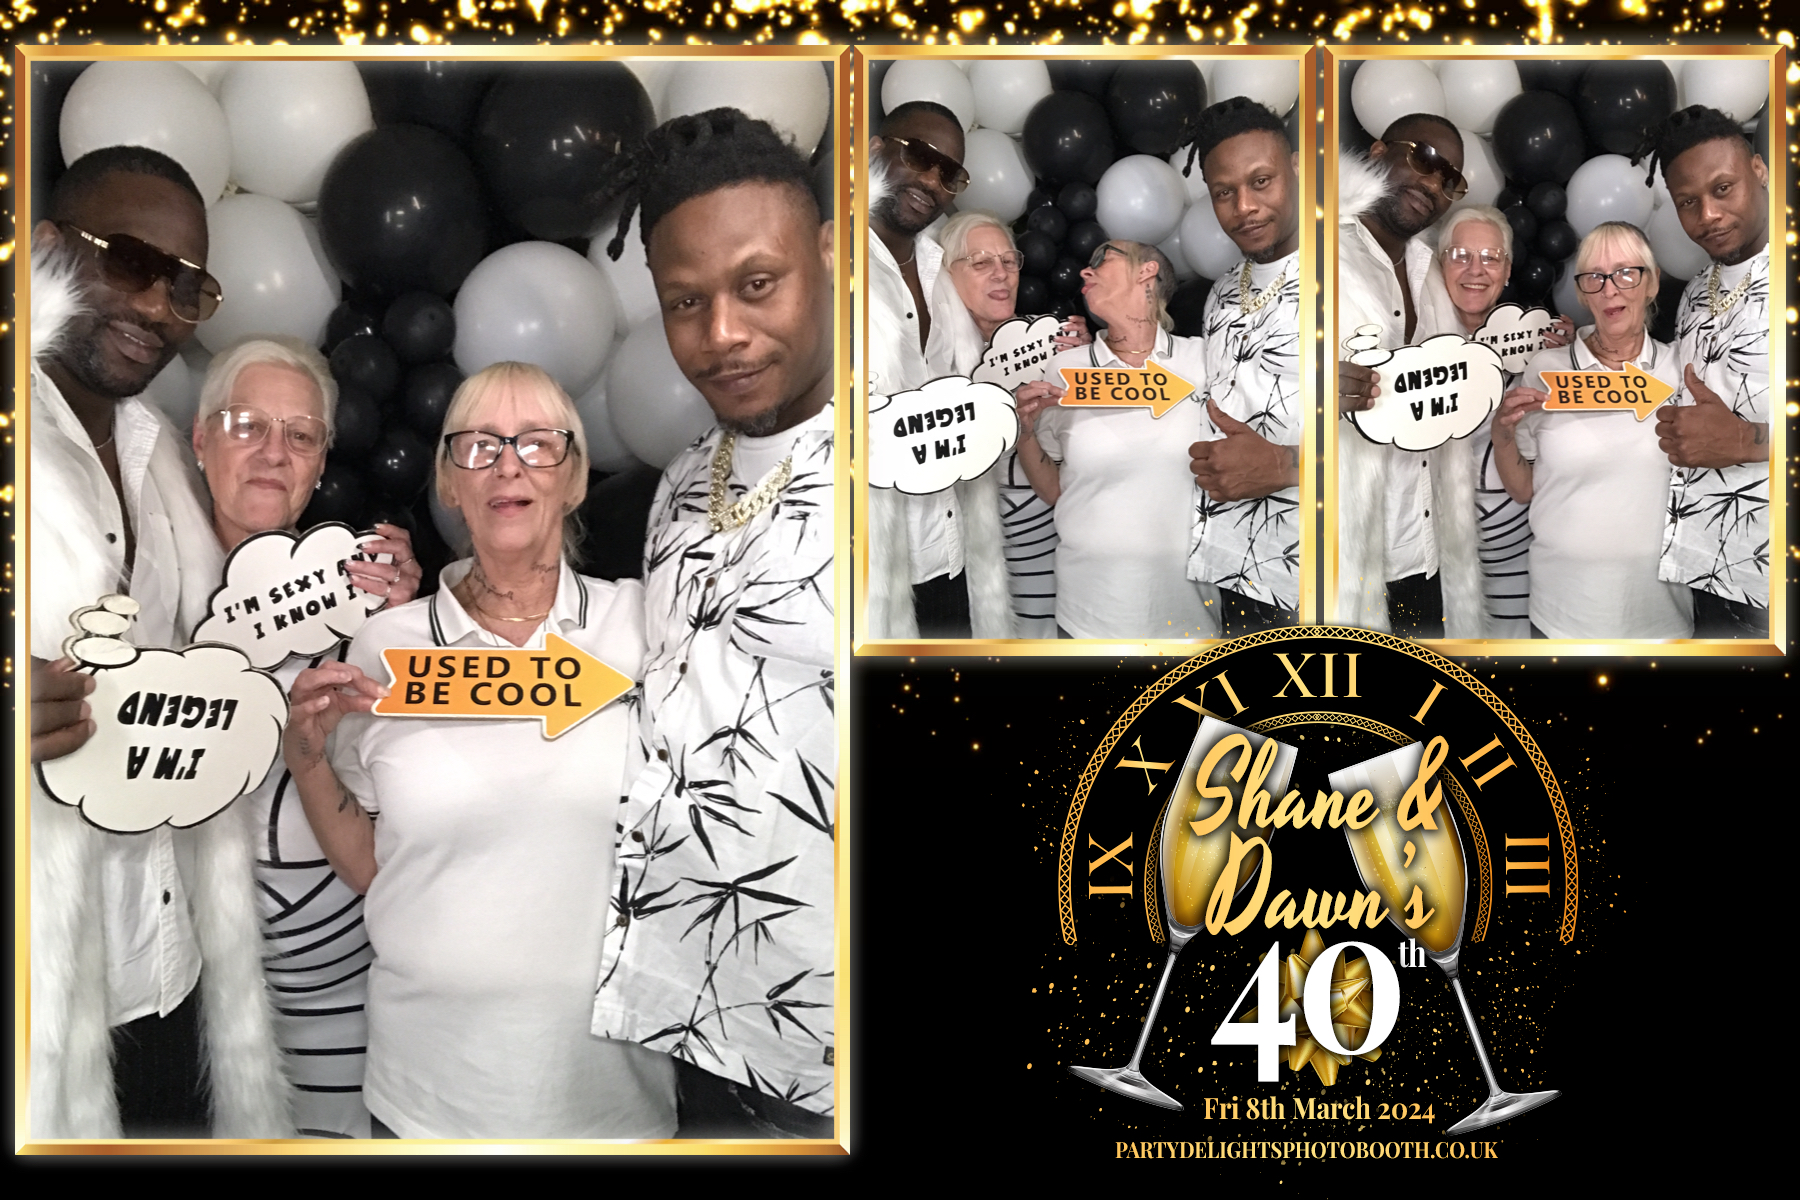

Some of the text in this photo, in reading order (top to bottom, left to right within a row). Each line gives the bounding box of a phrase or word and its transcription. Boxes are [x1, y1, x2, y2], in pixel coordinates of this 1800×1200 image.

[1503, 330, 1533, 343] SEXY
[989, 353, 1008, 367] I'M
[1013, 339, 1043, 358] SEXY
[1501, 343, 1534, 357] KNOW
[1003, 367, 1010, 376] I
[1014, 352, 1048, 372] KNOW
[1075, 373, 1166, 385] USED TO
[1395, 362, 1467, 393] LEGEND
[1556, 376, 1646, 388] USED TO
[1076, 387, 1170, 400] BE COOL
[1559, 391, 1651, 403] BE COOL
[1411, 393, 1457, 421] I'M A
[894, 403, 974, 438] LEGEND
[912, 435, 965, 464] I'M A
[224, 596, 260, 623] I'M
[269, 569, 325, 604] SEXY
[254, 622, 265, 640] I
[273, 592, 337, 631] KNOW
[409, 656, 580, 679] USED TO
[405, 682, 581, 706] BE COOL
[118, 692, 238, 730] LEGEND
[127, 747, 205, 779] I'M A
